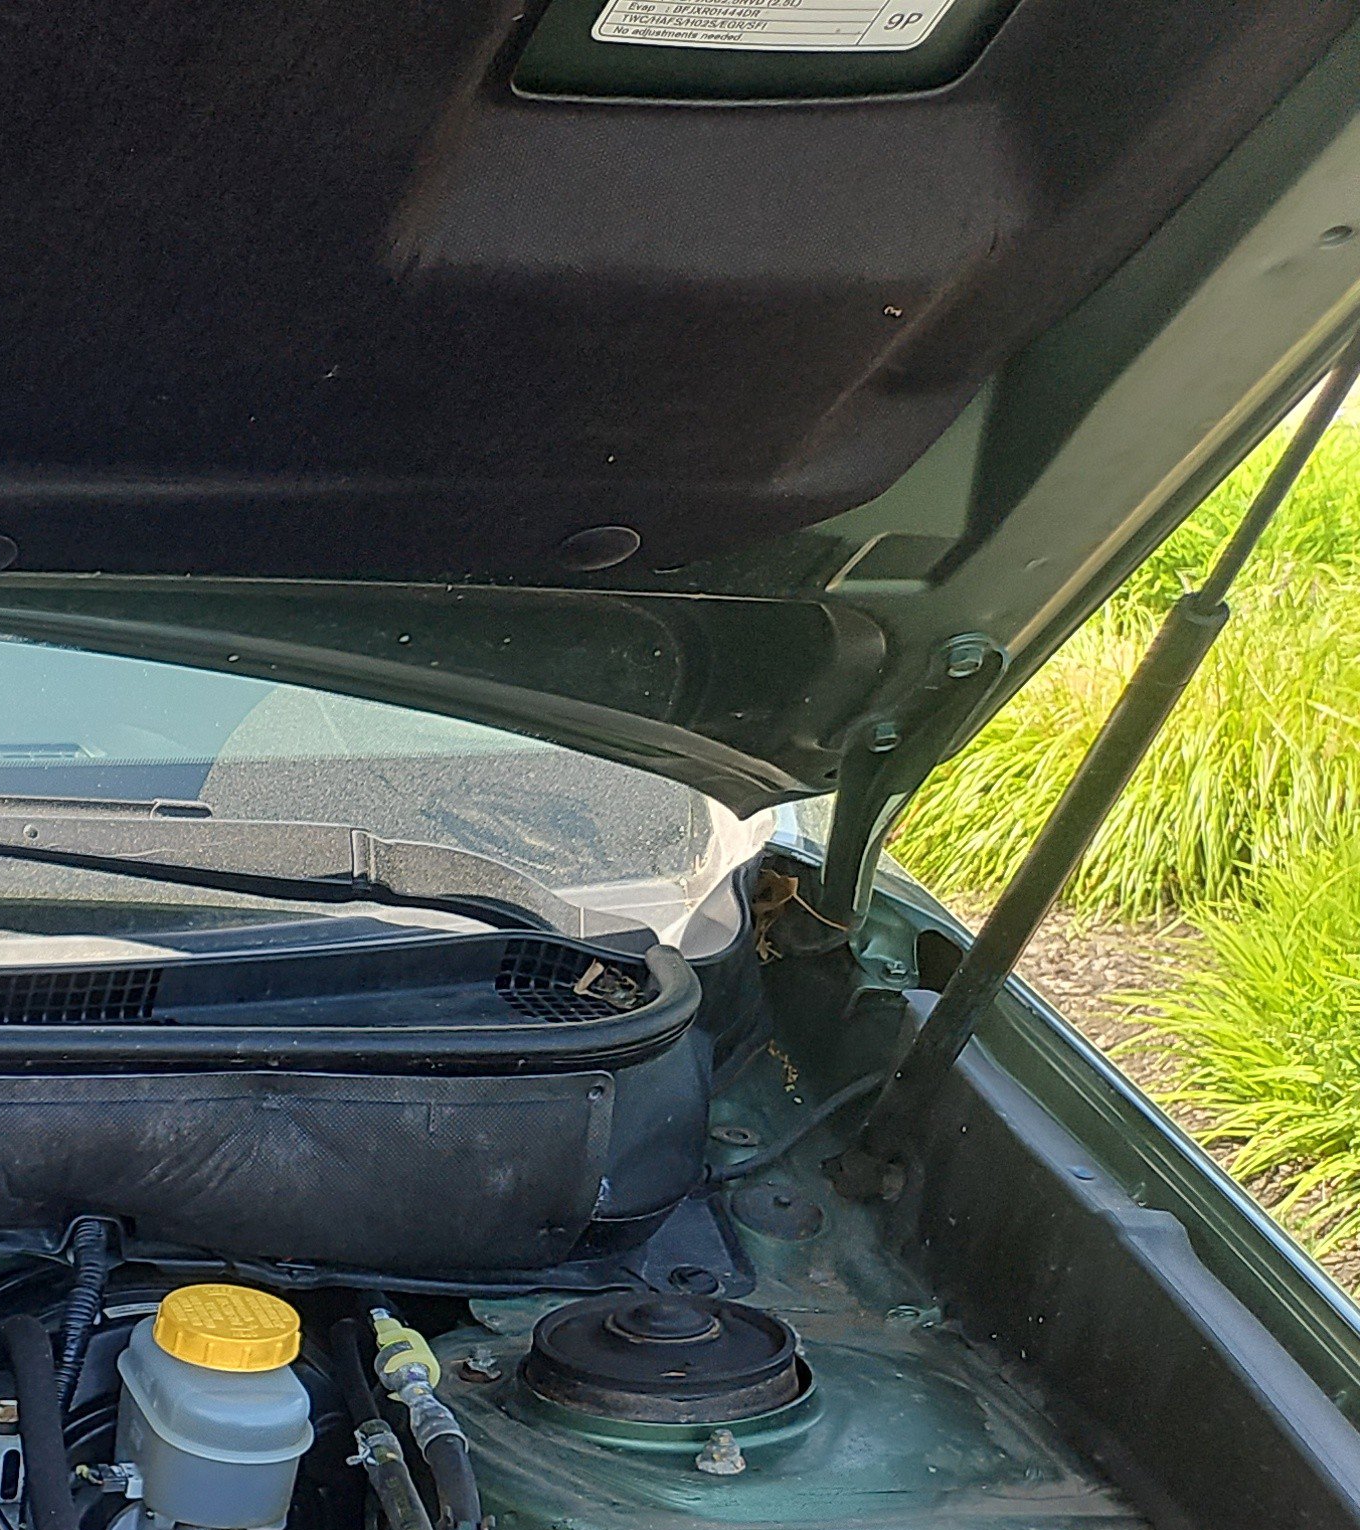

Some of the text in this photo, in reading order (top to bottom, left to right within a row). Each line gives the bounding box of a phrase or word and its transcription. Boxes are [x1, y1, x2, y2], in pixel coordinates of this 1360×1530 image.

[884, 12, 923, 31] 9P
[613, 25, 742, 41] No adjustments needed.
